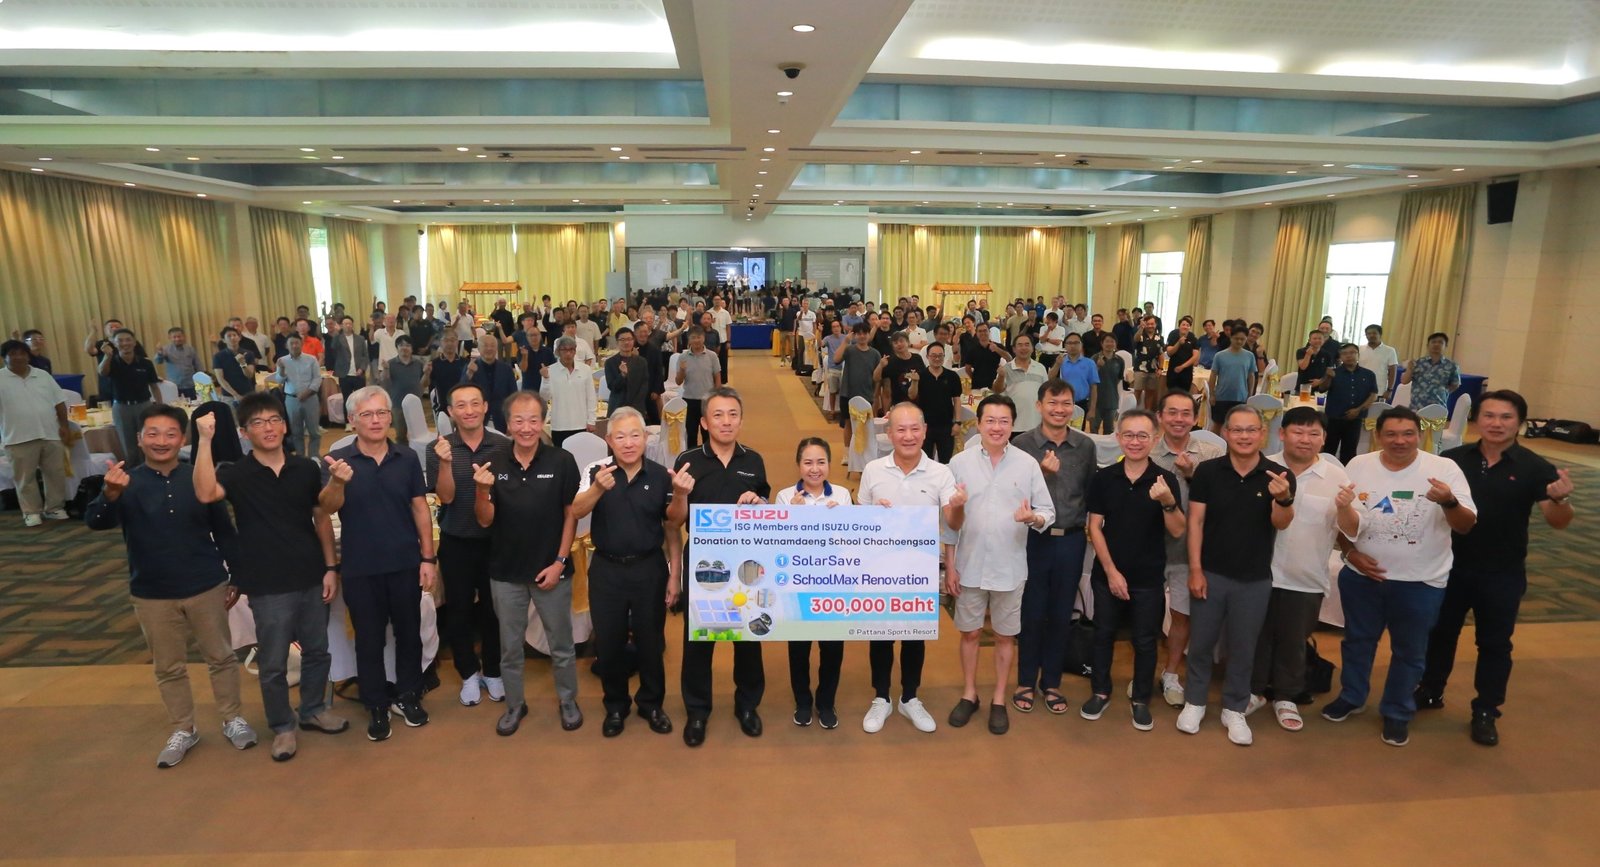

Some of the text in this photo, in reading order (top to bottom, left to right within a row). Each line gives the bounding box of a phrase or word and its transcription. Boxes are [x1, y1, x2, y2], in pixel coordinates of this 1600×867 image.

[696, 509, 731, 527] ISG
[735, 510, 789, 519] ISUZU
[734, 523, 751, 531] ISG
[753, 523, 798, 531] Members
[801, 523, 819, 531] and
[822, 523, 850, 531] ISUZU
[852, 523, 882, 533] Group
[693, 537, 739, 545] Donation
[753, 537, 826, 547] Watnamdaeng
[828, 538, 861, 546] School
[863, 538, 936, 547] Chachoengsao
[792, 555, 861, 566] SolarSave
[792, 574, 859, 585] SchoolMax
[862, 574, 929, 585] Renovation
[811, 598, 934, 614] 300,000 Baht
[887, 629, 911, 637] Sports
